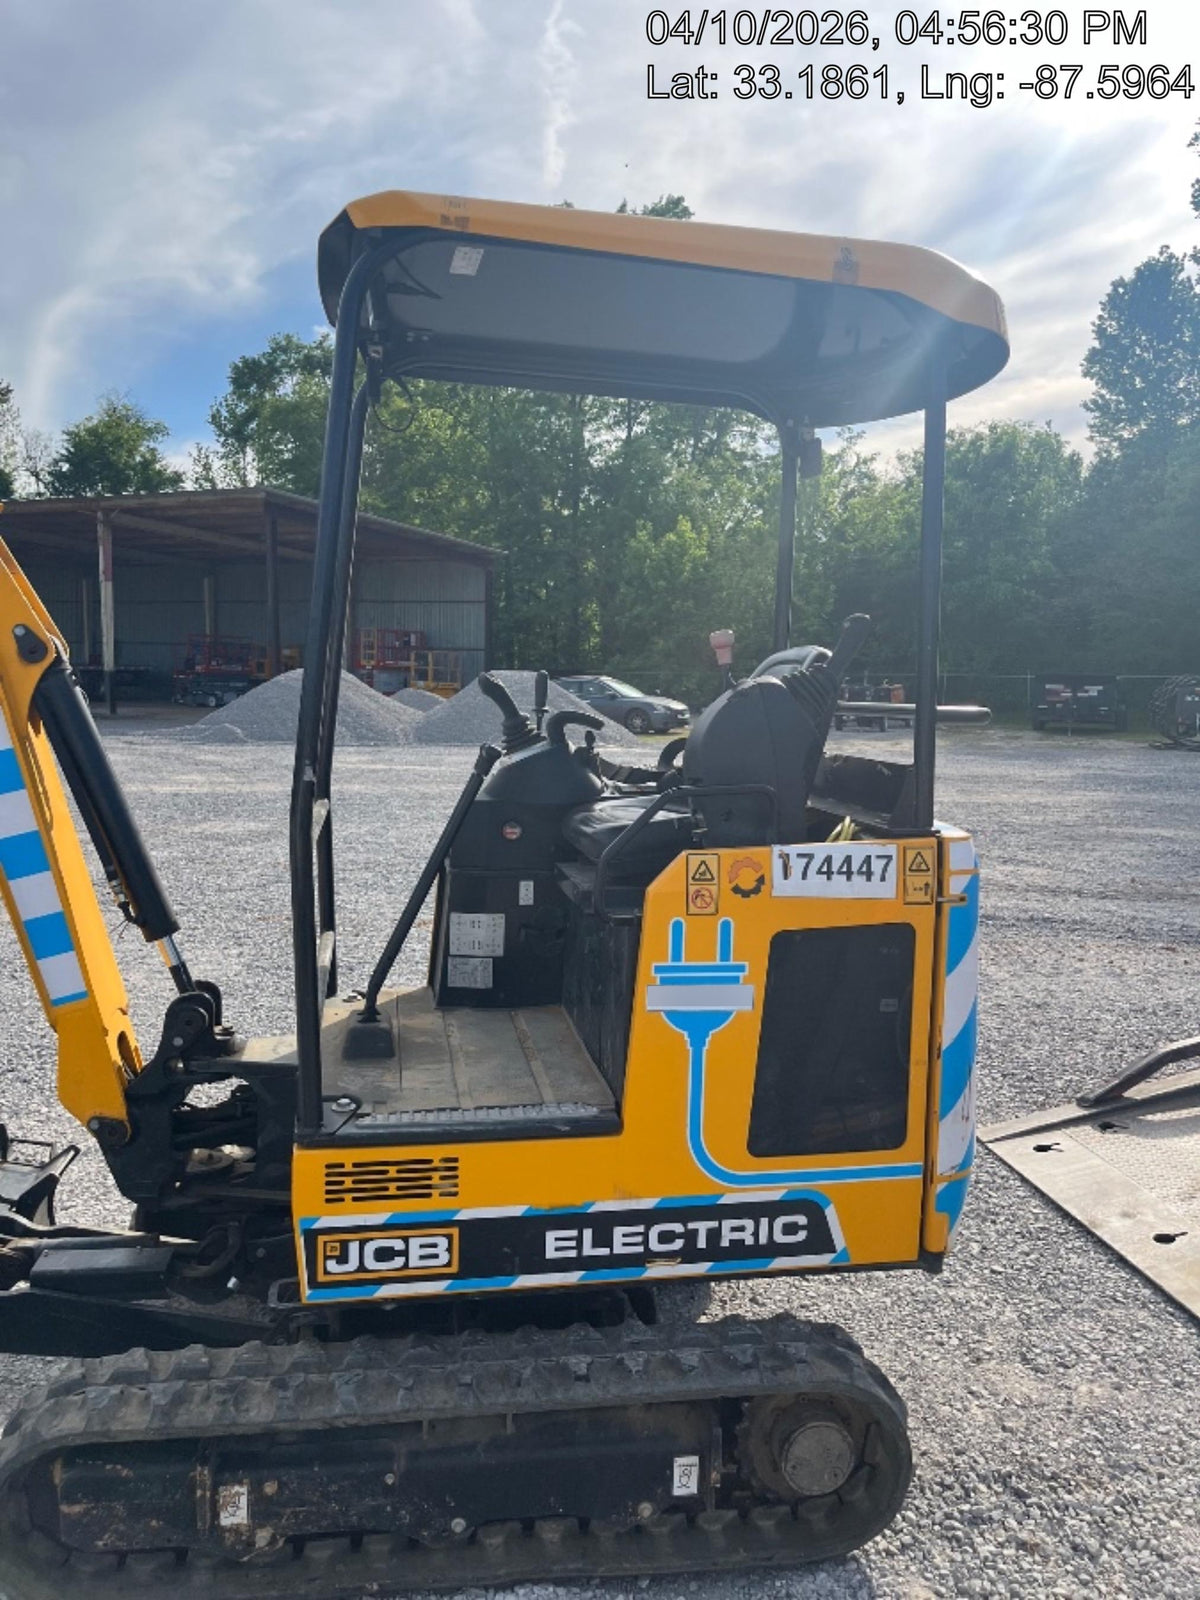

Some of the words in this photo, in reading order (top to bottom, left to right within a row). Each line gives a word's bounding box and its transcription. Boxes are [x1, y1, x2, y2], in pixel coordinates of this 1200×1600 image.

[778, 848, 894, 884] 174447
[326, 1236, 450, 1273] JCB
[545, 1215, 808, 1259] ELECTRIC
